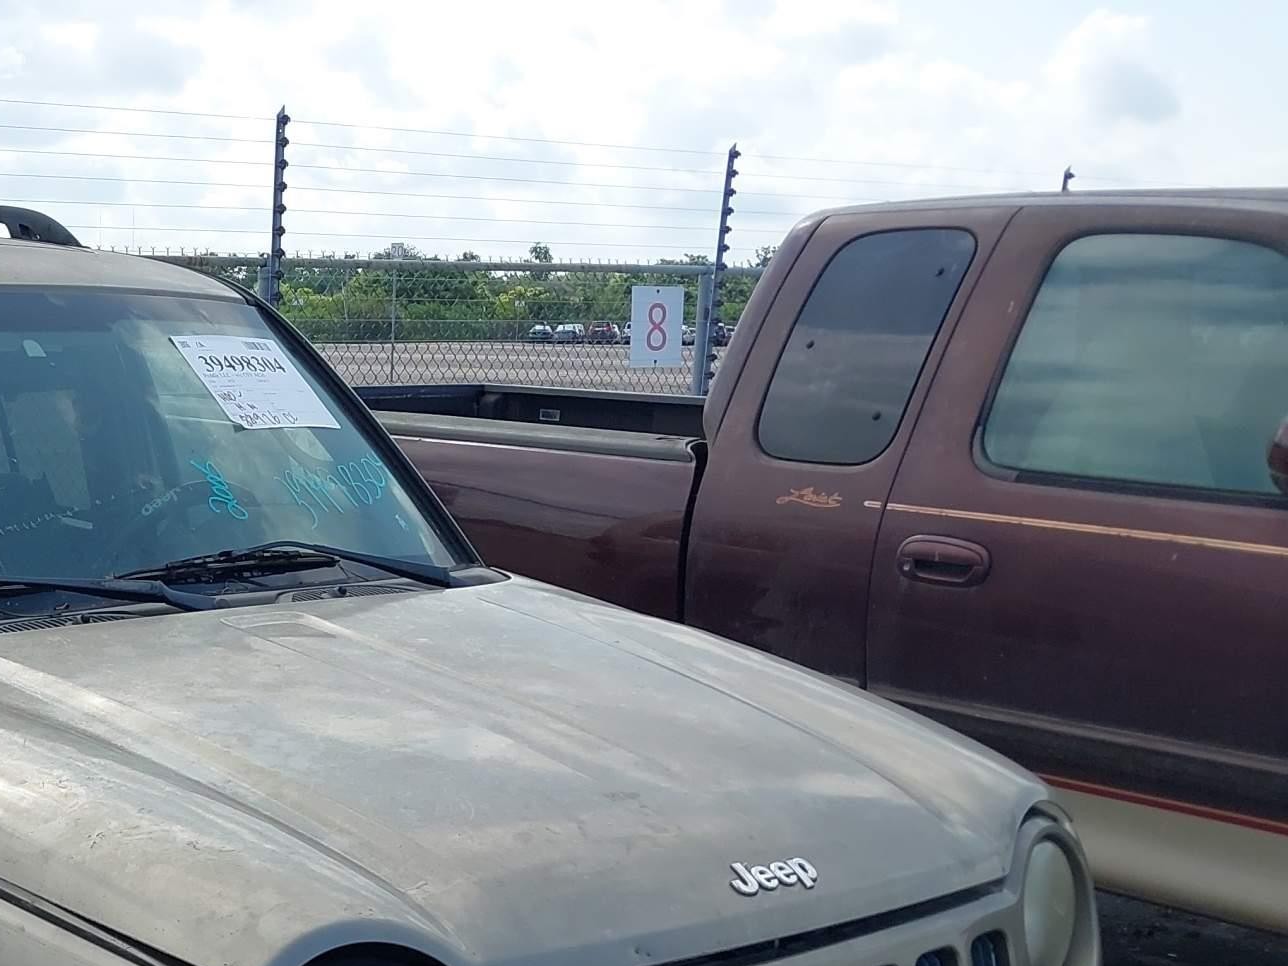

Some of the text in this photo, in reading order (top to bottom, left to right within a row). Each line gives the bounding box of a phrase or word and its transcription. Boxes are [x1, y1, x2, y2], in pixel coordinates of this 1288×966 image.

[646, 302, 667, 352] 8
[198, 354, 287, 374] 39498304
[730, 857, 818, 897] Jeep
